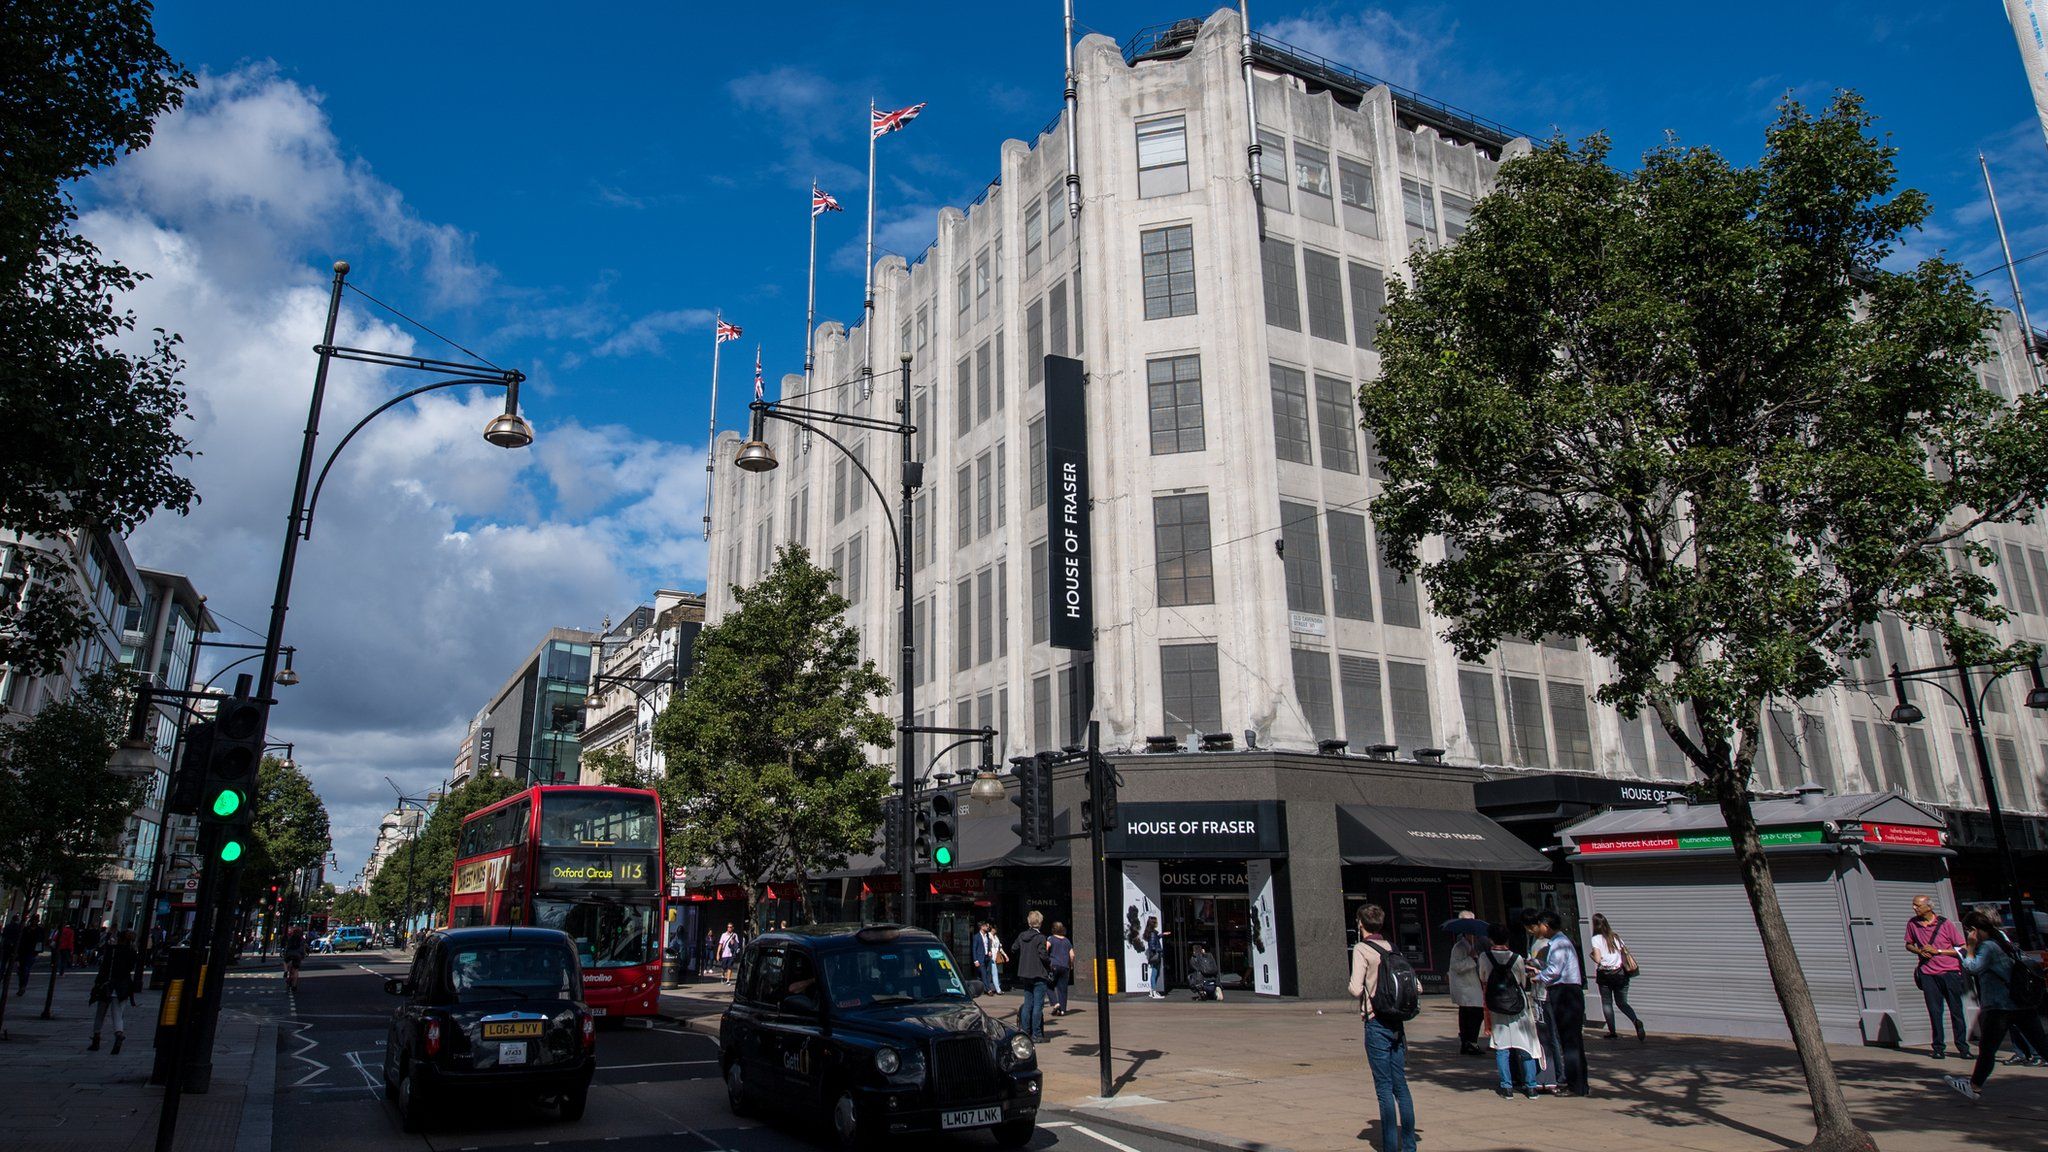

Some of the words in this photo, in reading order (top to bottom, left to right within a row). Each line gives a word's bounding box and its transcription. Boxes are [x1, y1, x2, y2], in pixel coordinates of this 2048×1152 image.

[1063, 462, 1077, 524] FRASER
[1065, 528, 1078, 553] OF
[1065, 557, 1080, 618] HOUSE
[1621, 787, 1653, 801] HOUSE
[1654, 792, 1668, 802] OF
[1127, 822, 1176, 834] HOUSE
[1179, 821, 1199, 834] OF
[1202, 821, 1256, 834] FRASER
[1616, 840, 1641, 848] Street
[1642, 838, 1674, 847] Kitchen
[553, 867, 584, 878] Oxford
[586, 867, 613, 878] Circus
[621, 864, 642, 878] 113
[1162, 873, 1197, 885] OUSE
[1199, 873, 1217, 885] OF
[1540, 882, 1554, 891] Dior
[1400, 897, 1417, 905] ATM
[490, 1024, 515, 1035] LO64
[518, 1023, 538, 1034] JYV
[784, 1051, 800, 1071] Gett
[946, 1111, 975, 1125] LM07
[977, 1108, 998, 1122] LNK
